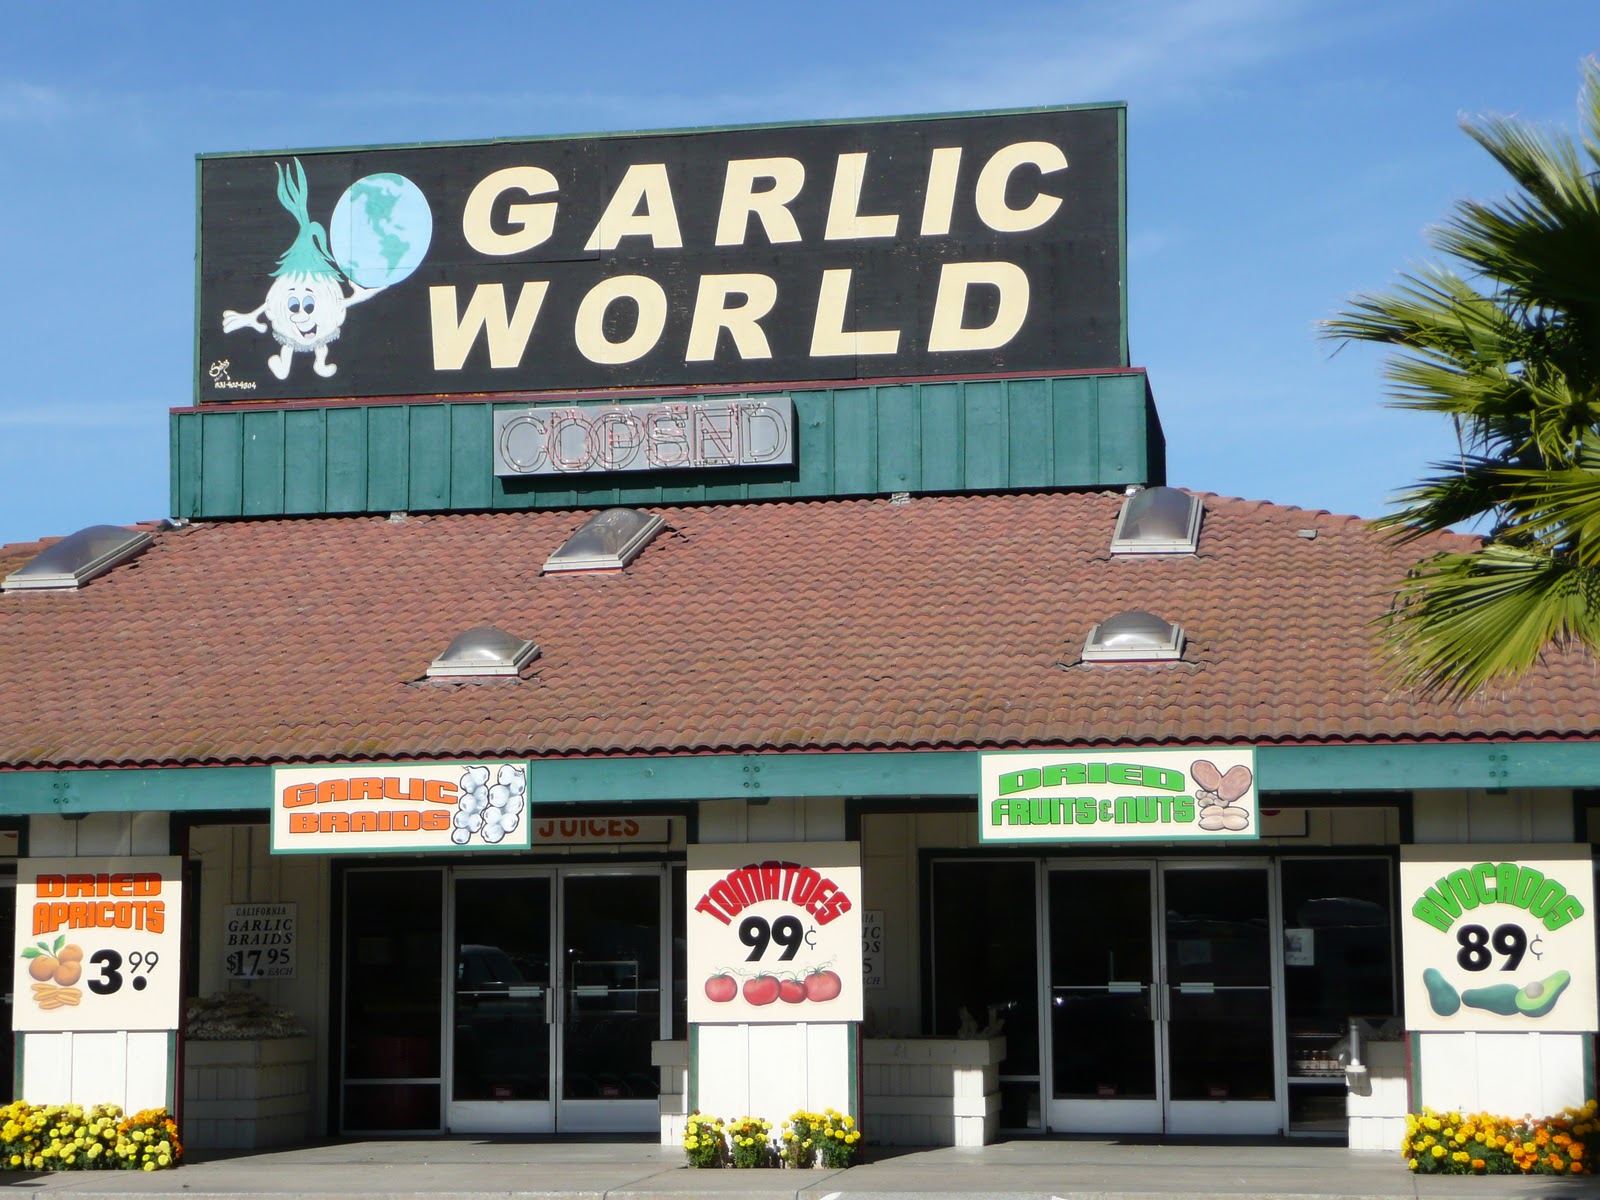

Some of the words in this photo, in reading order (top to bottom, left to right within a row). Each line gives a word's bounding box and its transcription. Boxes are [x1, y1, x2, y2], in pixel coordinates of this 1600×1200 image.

[463, 141, 1068, 256] GARLIC
[429, 261, 1030, 371] WORLD
[283, 777, 459, 808] GARLIC
[999, 762, 1185, 796] DRIED
[289, 809, 451, 834] BRAIDS
[991, 797, 1097, 826] FRUITS
[1114, 795, 1195, 824] NUTS
[539, 819, 640, 838] JUICES
[36, 872, 162, 898] DRIED
[694, 860, 852, 926] TOMATOES
[1412, 862, 1585, 933] AVOCADOS
[32, 900, 166, 936] APRICOTS
[228, 918, 293, 933] GARLIC
[236, 906, 287, 917] CALIFORNIA
[227, 932, 293, 946] BRAIDS
[267, 966, 293, 977] EACH
